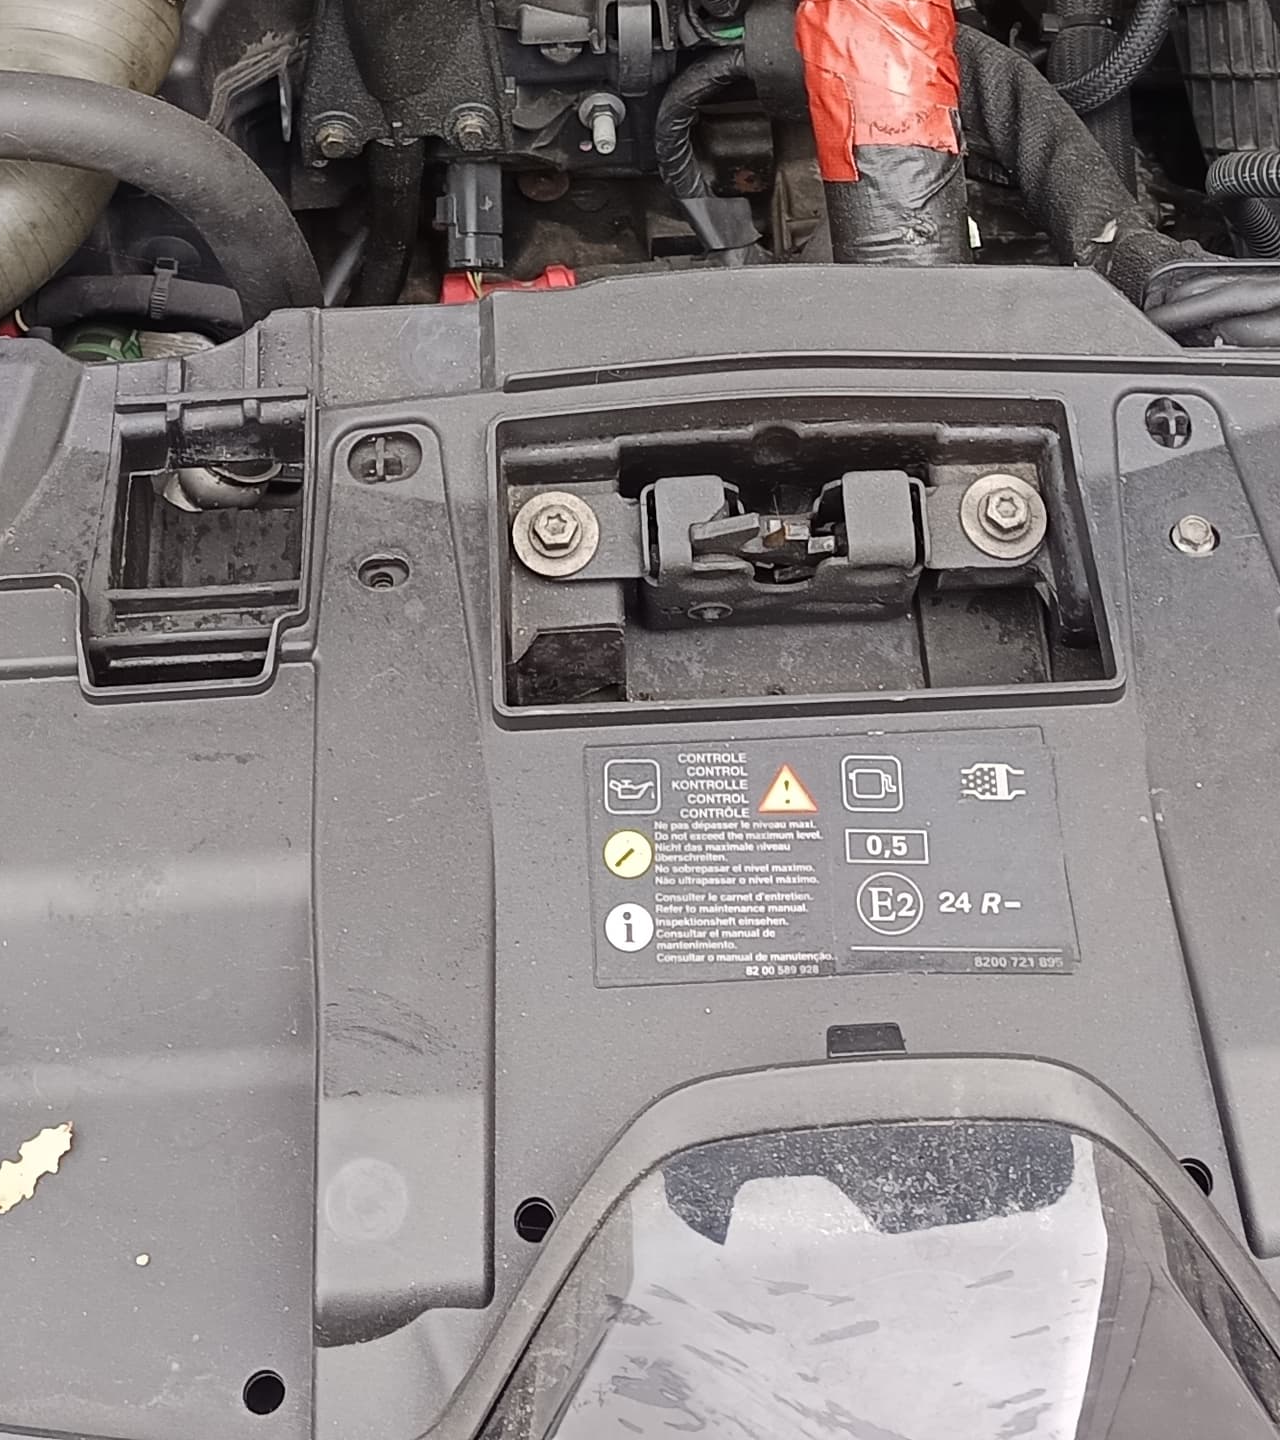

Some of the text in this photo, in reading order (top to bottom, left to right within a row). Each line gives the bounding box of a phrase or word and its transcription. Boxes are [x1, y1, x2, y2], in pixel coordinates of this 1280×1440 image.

[678, 752, 747, 763] CONTROLE
[686, 766, 748, 776] CONTROL
[671, 779, 748, 790] KONTROLLE
[687, 793, 749, 804] CONTROL
[680, 806, 750, 819] CONTRÔLE
[654, 822, 668, 830] Ne
[671, 823, 689, 831] pas
[692, 821, 738, 831] dépasser
[741, 821, 750, 829] le
[753, 821, 786, 829] niveau
[655, 831, 823, 841] Do not exceed the maximum level.
[655, 843, 681, 851] Nicht
[684, 843, 703, 851] das
[705, 842, 754, 851] maximale
[866, 835, 908, 858] 0,5
[655, 865, 669, 873] No
[672, 864, 730, 874] sobrepasar
[733, 864, 742, 872] el
[744, 864, 769, 872] nivel
[678, 876, 736, 886] ultrapassar
[749, 875, 773, 884] nivel
[655, 893, 705, 902] Consulter
[709, 893, 717, 902] le
[720, 893, 753, 902] carnet
[655, 904, 808, 913] Refer to maintenance manual.
[868, 886, 916, 922] E2
[938, 892, 972, 913] 24
[656, 929, 776, 938] Consultar el manual de
[657, 953, 705, 963] Consultar
[717, 953, 753, 962] manual
[756, 952, 768, 961] de
[974, 957, 1007, 968] 8200
[1011, 957, 1034, 968] 721
[745, 967, 759, 976] 82
[762, 967, 775, 976] 00
